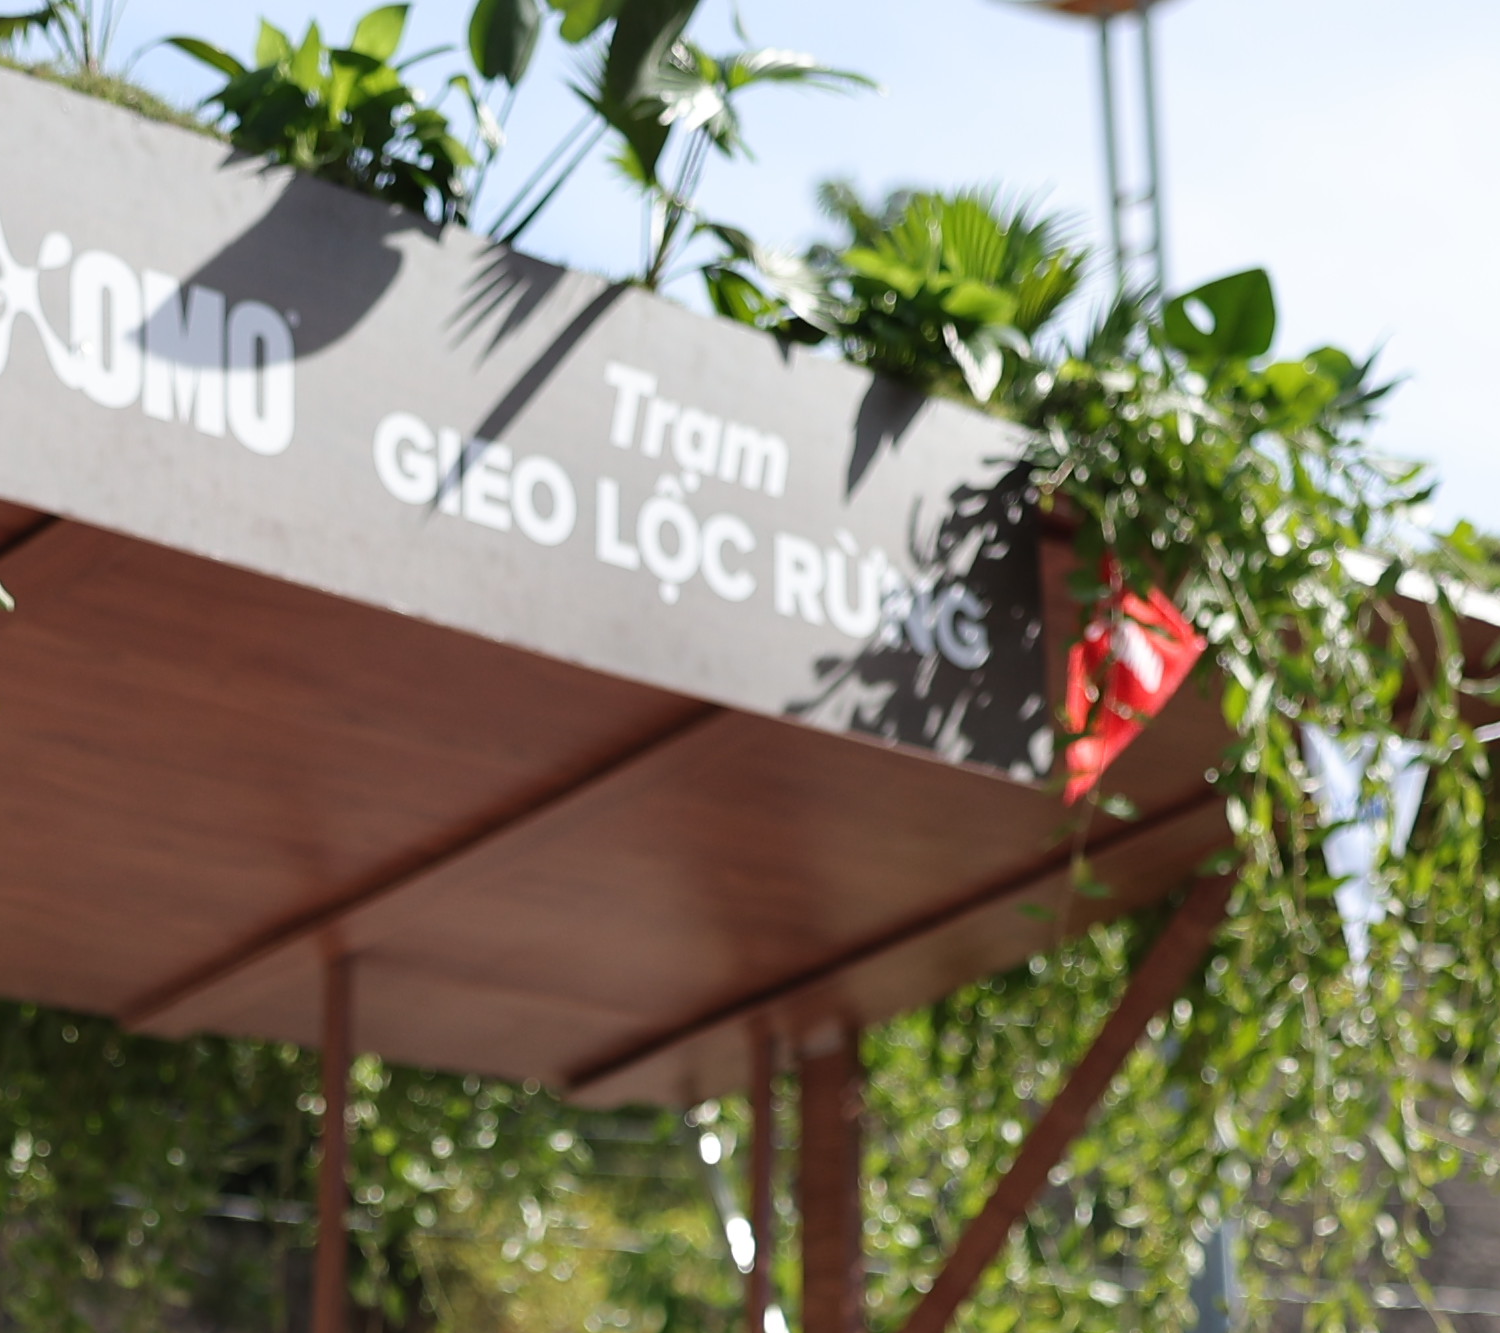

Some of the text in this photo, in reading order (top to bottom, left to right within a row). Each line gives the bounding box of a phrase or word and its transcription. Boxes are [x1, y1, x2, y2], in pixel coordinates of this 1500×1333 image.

[69, 248, 296, 455] OMO
[604, 361, 789, 499] Trạm
[373, 411, 576, 547] GIEO
[596, 472, 757, 605] LỘC
[774, 526, 991, 669] RỪNG
